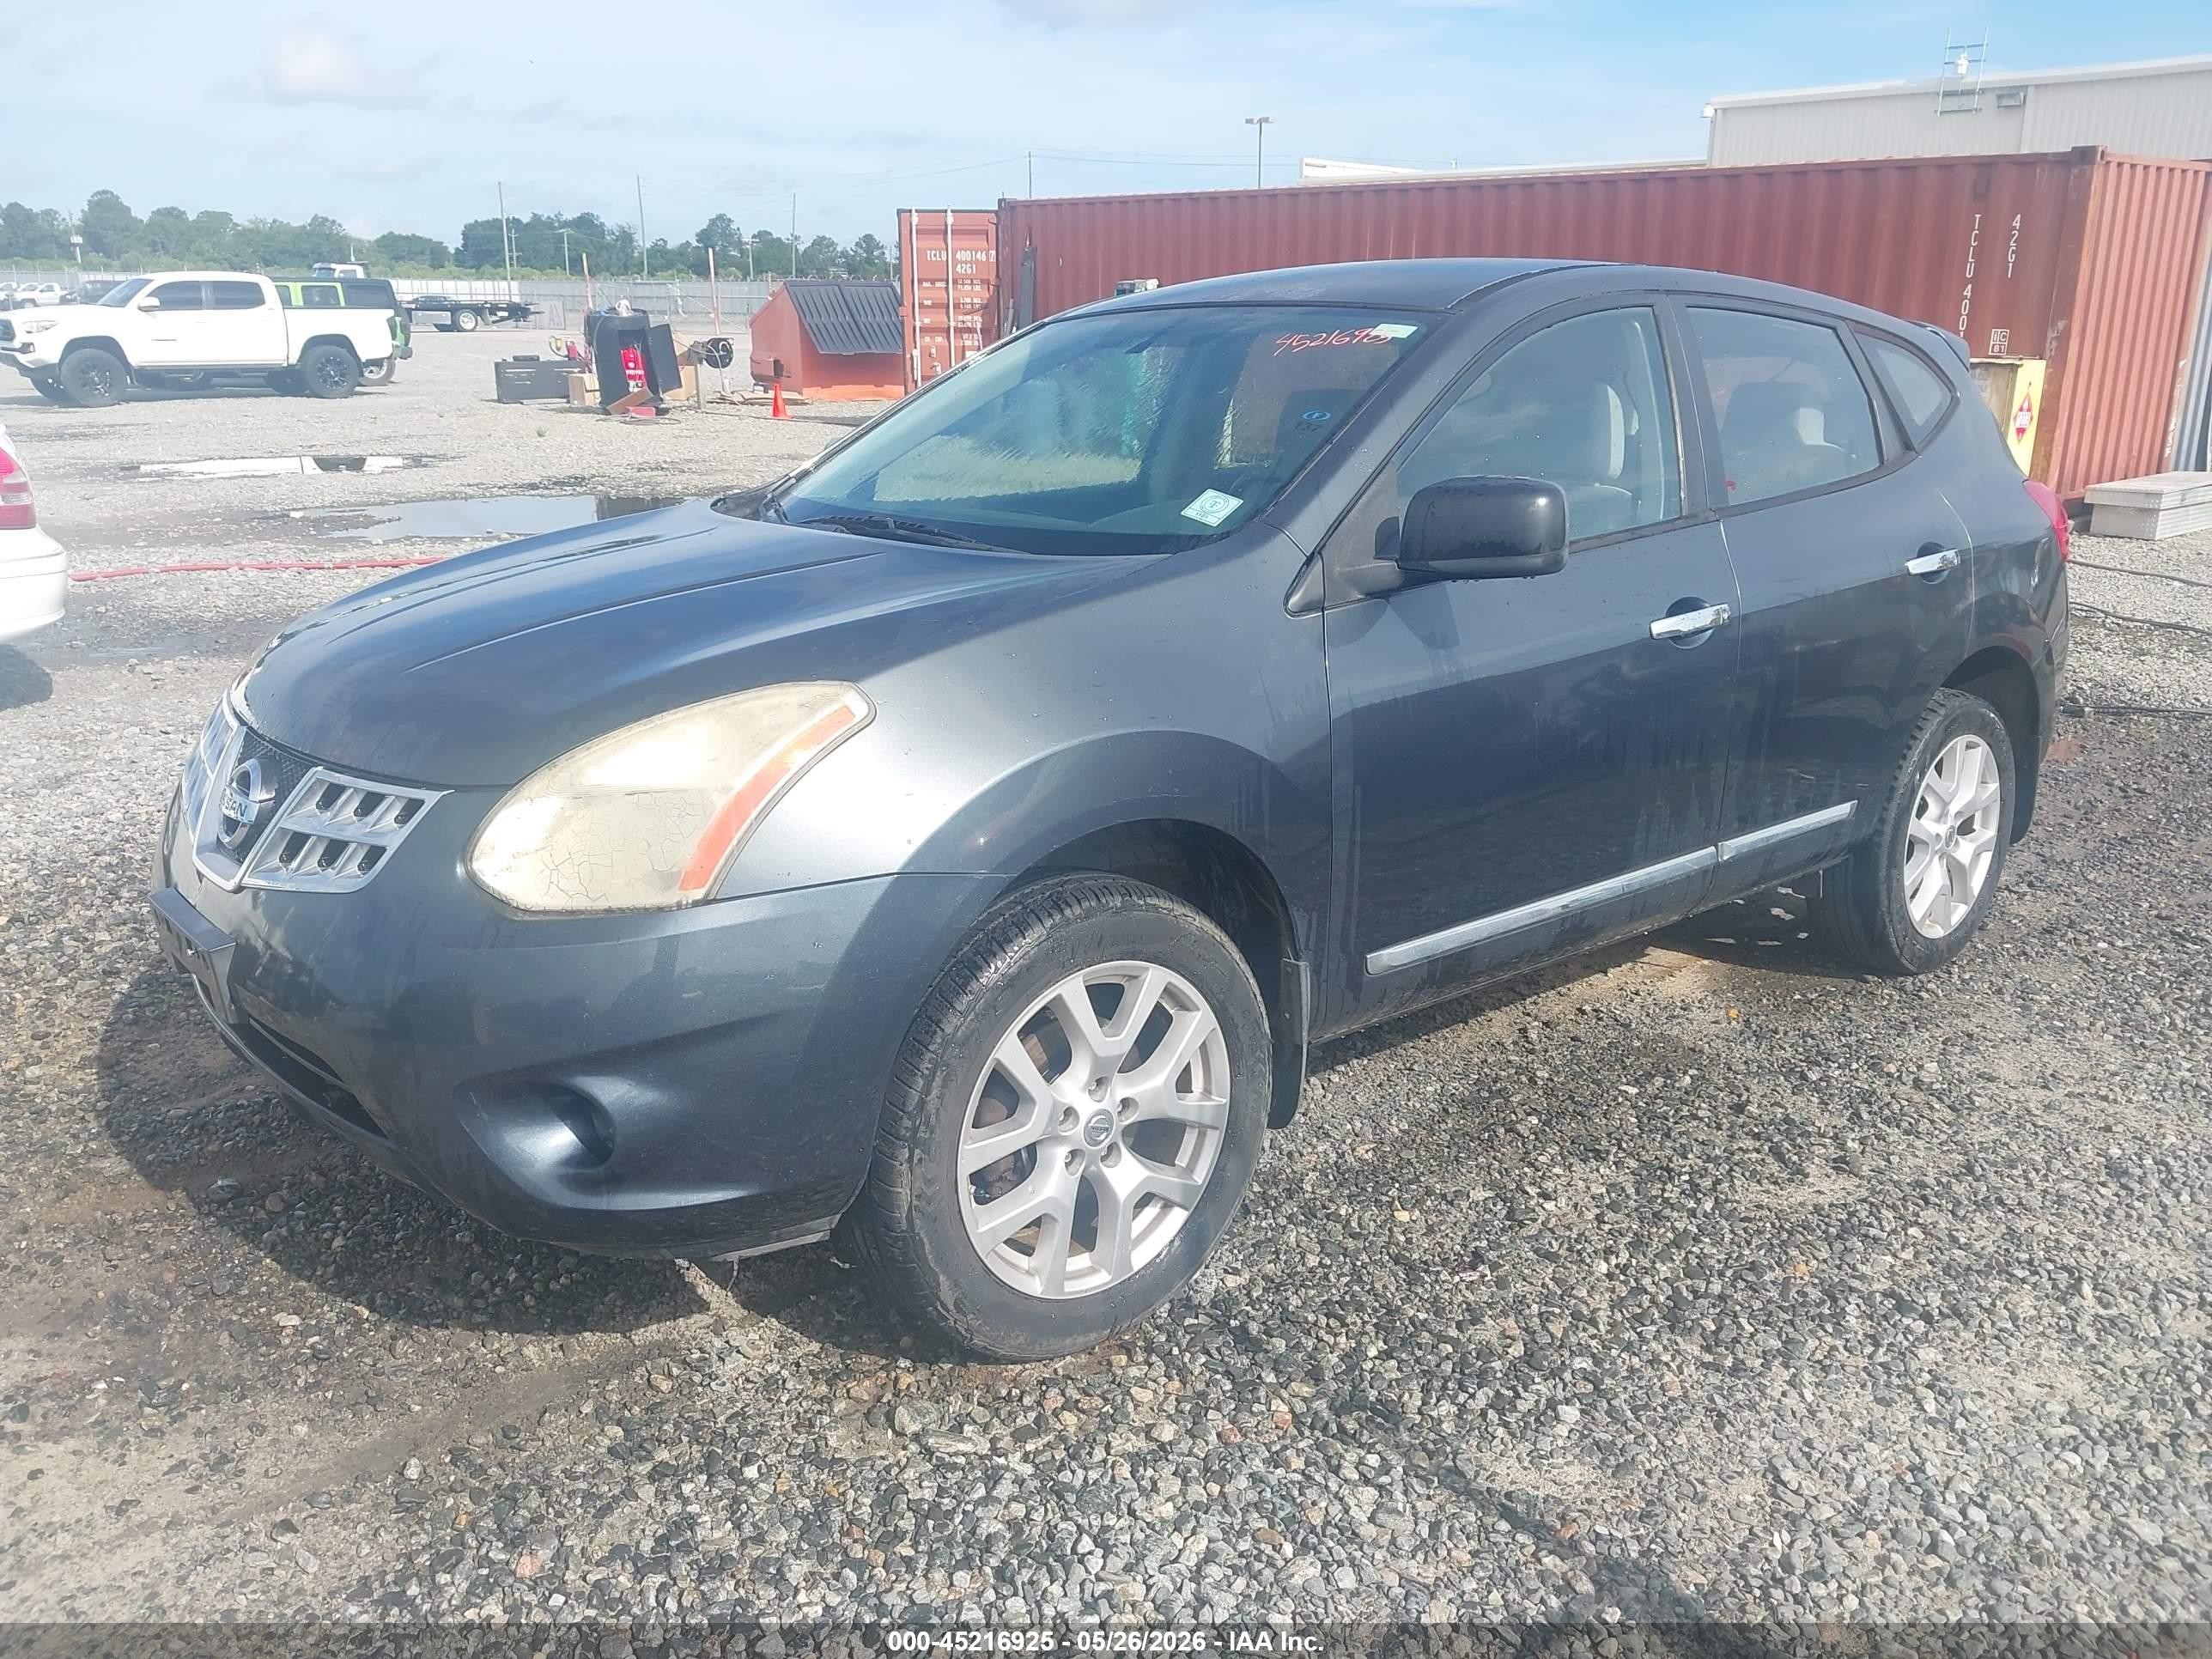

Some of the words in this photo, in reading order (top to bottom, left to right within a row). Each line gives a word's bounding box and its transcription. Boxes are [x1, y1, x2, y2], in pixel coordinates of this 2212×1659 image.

[926, 249, 947, 261] TCLU
[956, 249, 987, 262] 400146
[1966, 214, 1982, 278] TCLU
[2007, 214, 2021, 278] 42G1
[1993, 343, 2005, 353] 81
